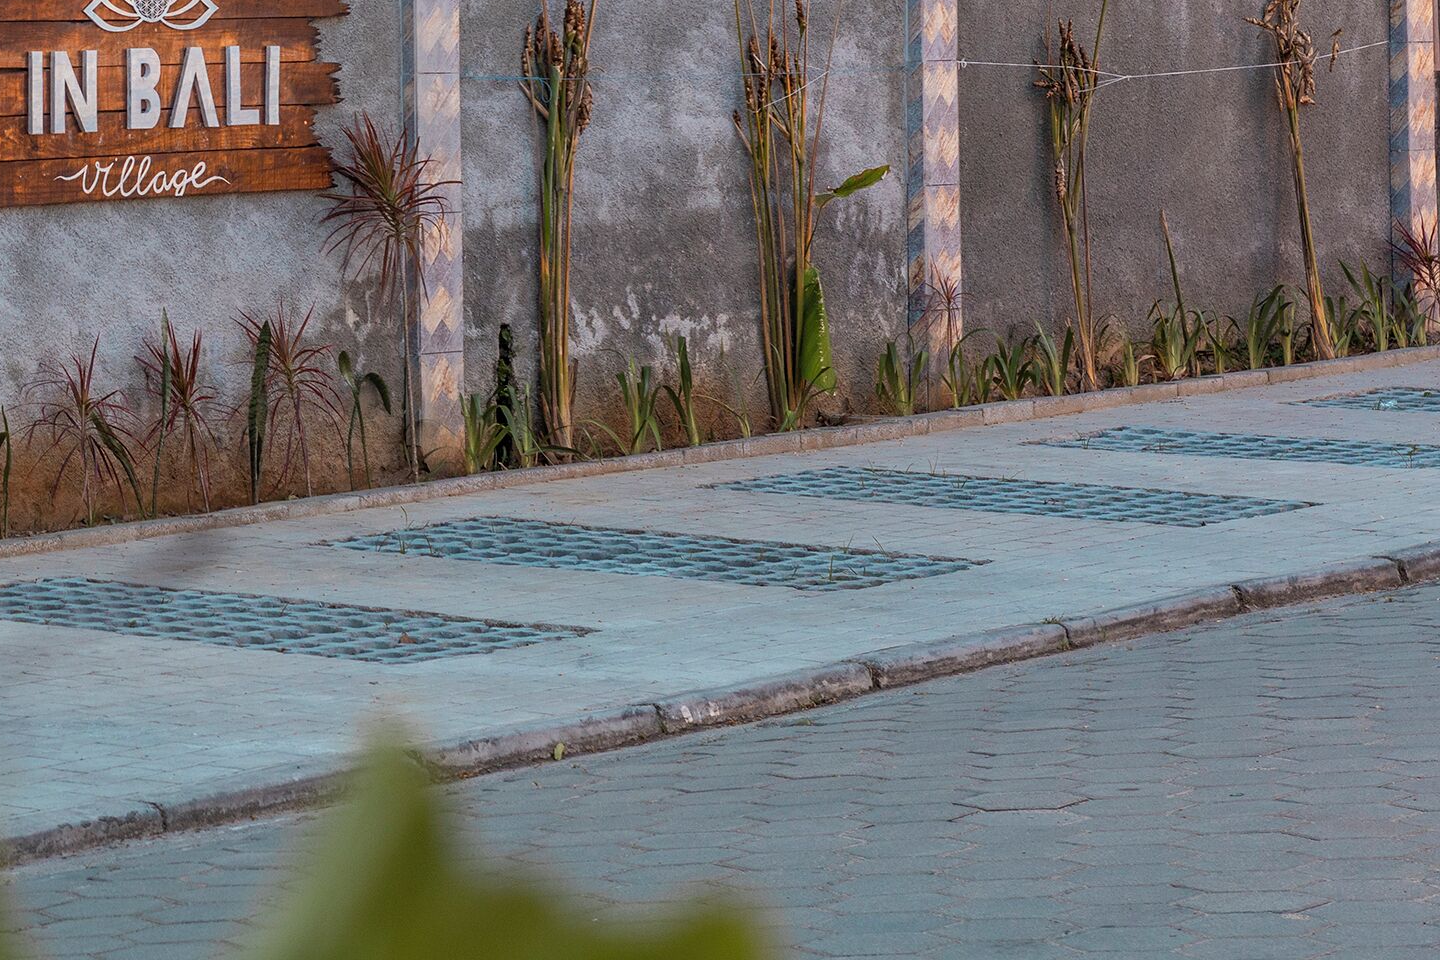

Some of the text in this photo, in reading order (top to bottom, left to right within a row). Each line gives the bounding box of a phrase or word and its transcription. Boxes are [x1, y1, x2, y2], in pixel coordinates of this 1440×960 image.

[27, 45, 281, 135] IN BALI
[53, 155, 231, 197] village
